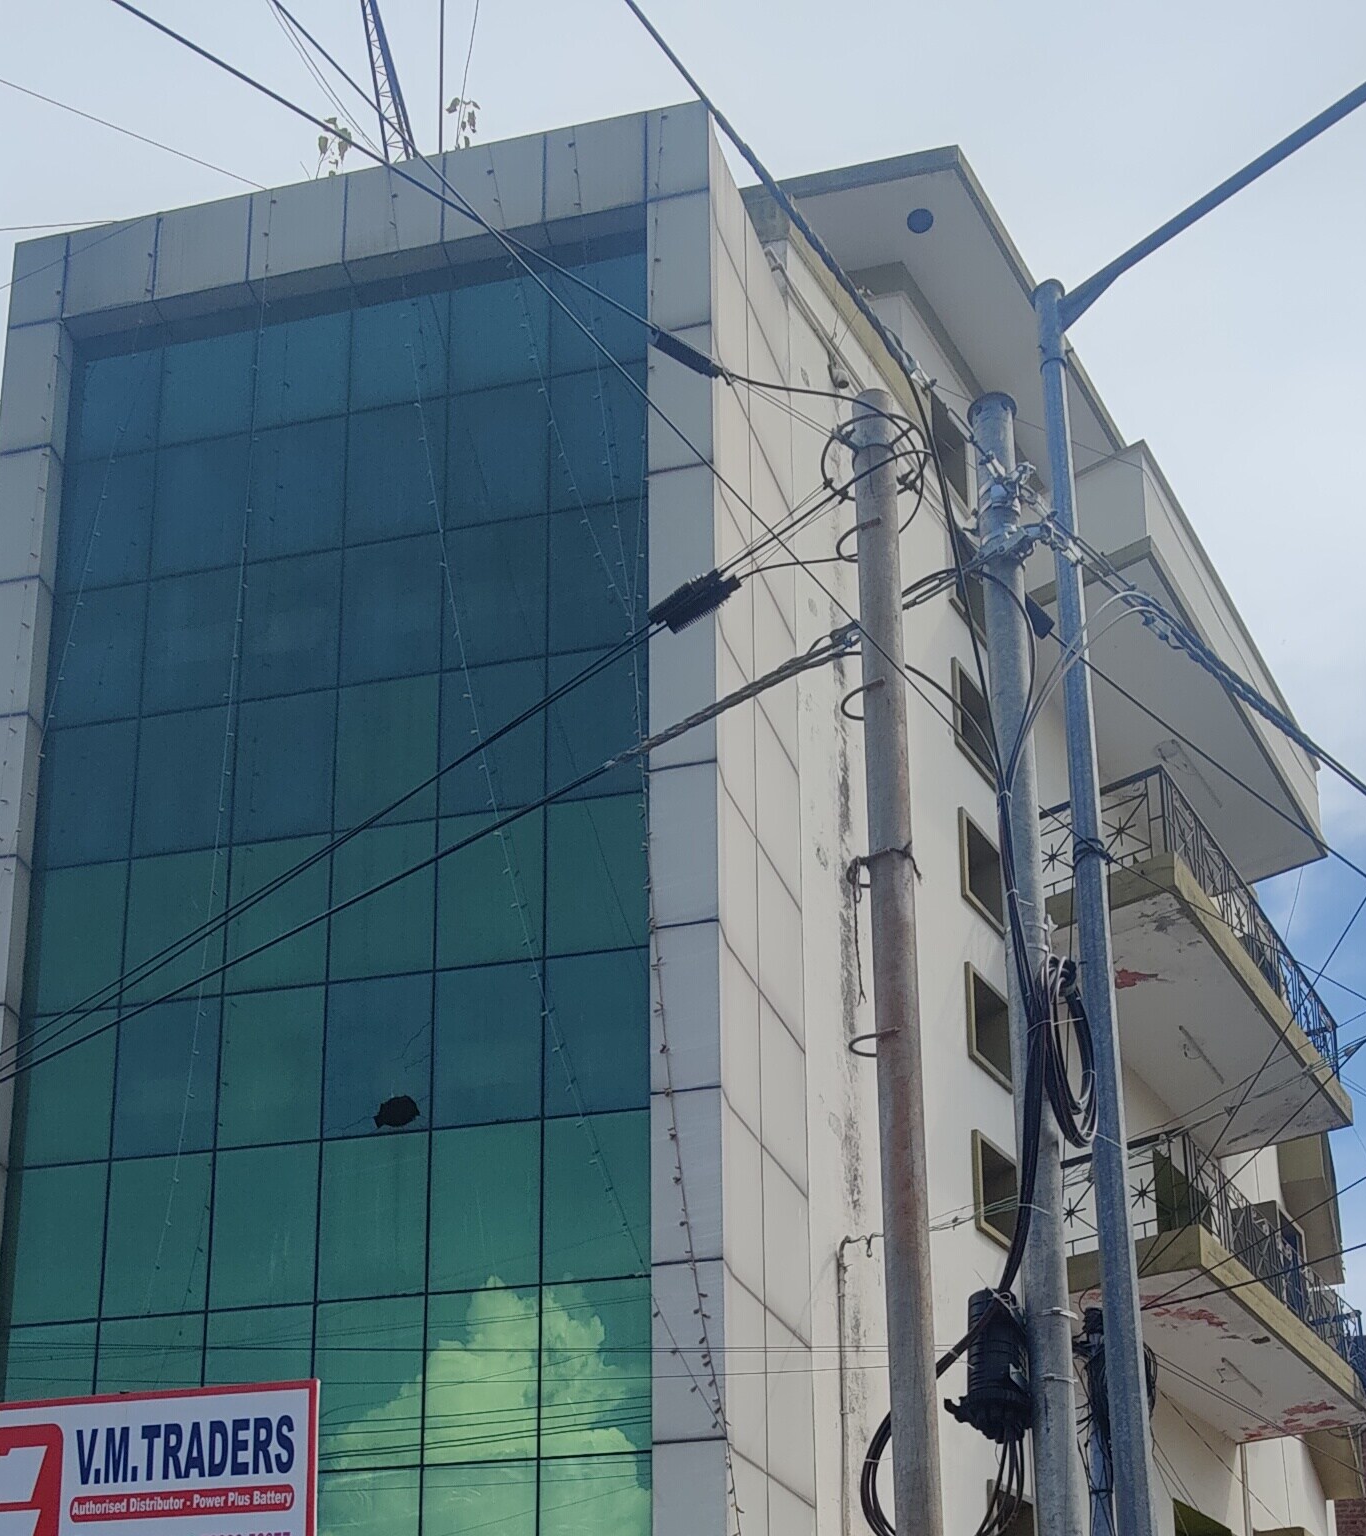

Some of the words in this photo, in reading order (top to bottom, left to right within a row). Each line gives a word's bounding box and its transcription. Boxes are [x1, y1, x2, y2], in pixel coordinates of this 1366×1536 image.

[76, 1414, 295, 1485] V.M.TRADERS
[71, 1496, 127, 1516] Authorised
[129, 1494, 185, 1513] Distributor
[193, 1494, 225, 1508] Power
[227, 1492, 250, 1506] Plus
[252, 1490, 293, 1508] Battery
